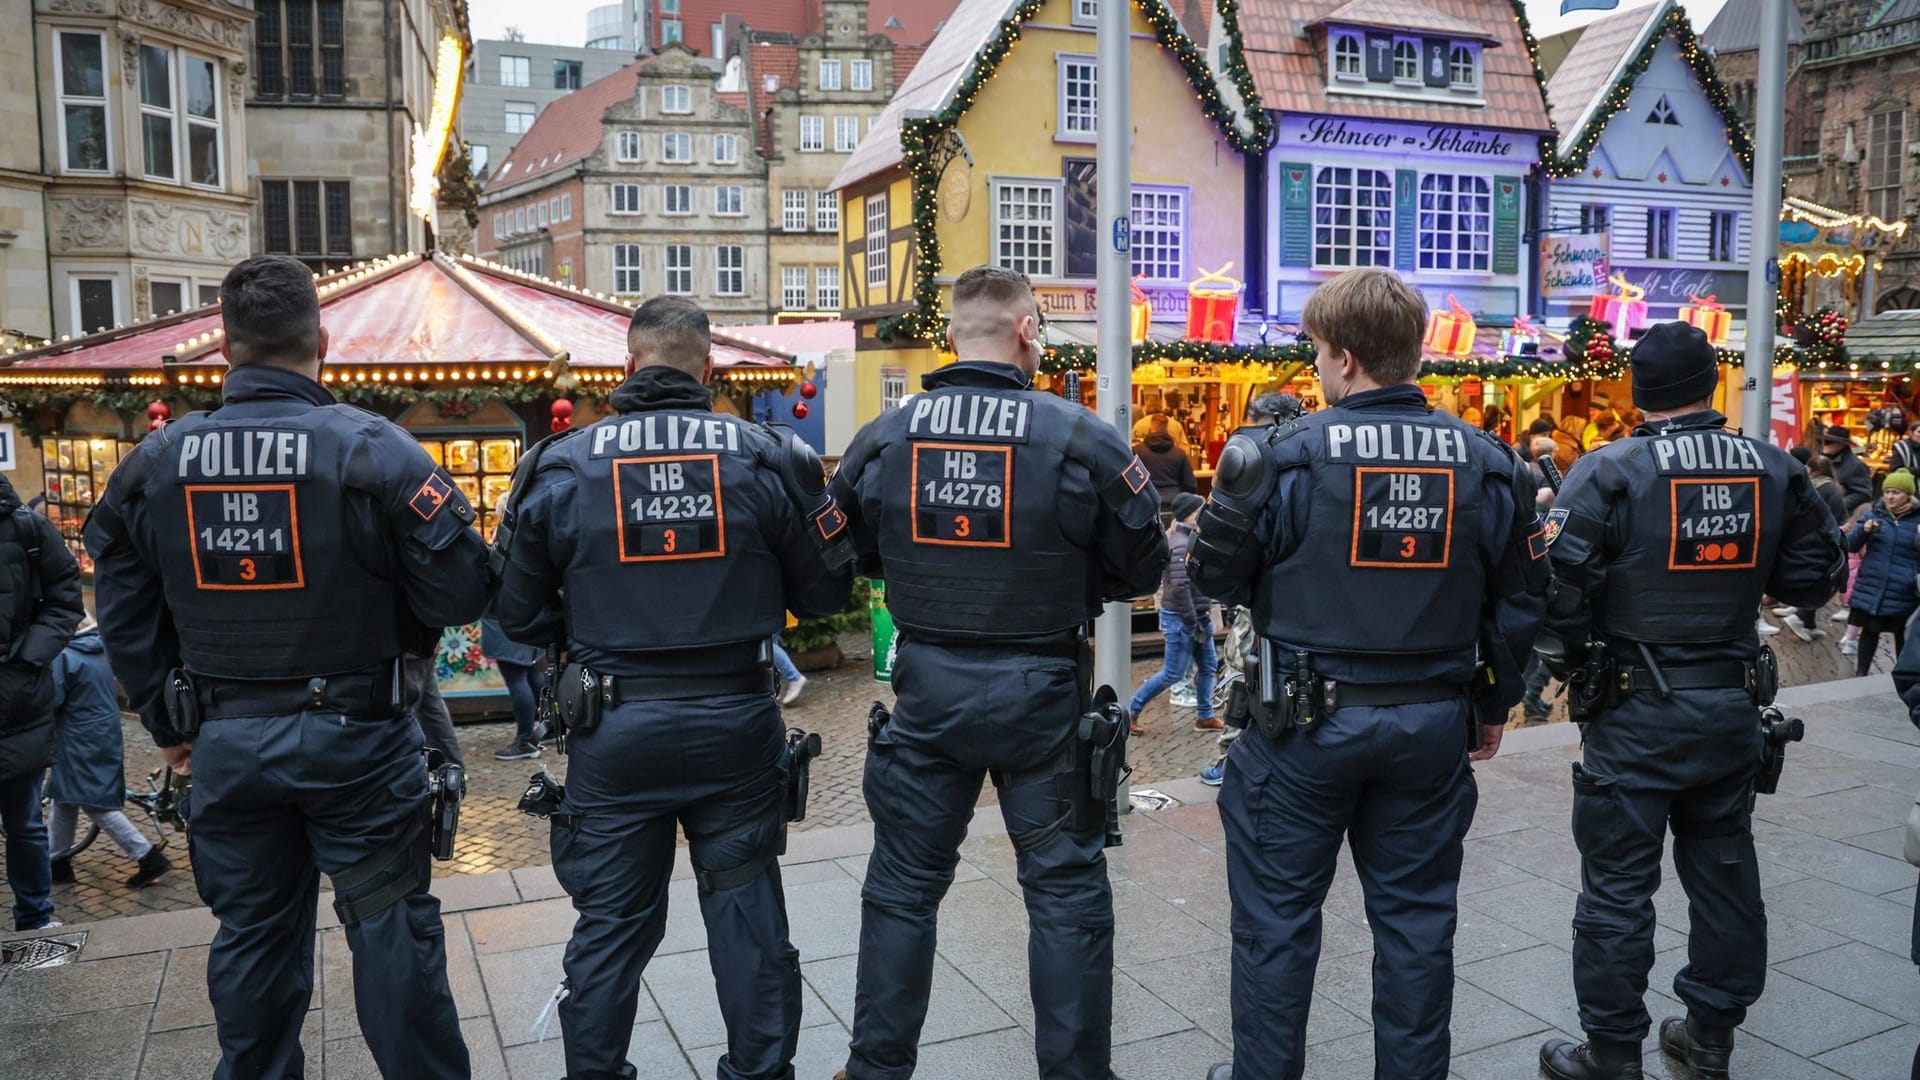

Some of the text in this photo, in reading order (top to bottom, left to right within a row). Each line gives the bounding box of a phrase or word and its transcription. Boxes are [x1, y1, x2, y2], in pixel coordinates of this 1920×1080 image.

[1300, 117, 1397, 148] Schnoor
[1419, 128, 1512, 156] Schänke
[1543, 269, 1594, 289] Schänke
[1041, 293, 1077, 313] zum
[909, 394, 1028, 438] POLIZEI
[593, 415, 739, 455] POLIZEI
[1328, 424, 1468, 463] POLIZEI
[178, 431, 308, 478] POLIZEI
[943, 450, 977, 480] HB
[1654, 434, 1765, 470] POLIZEI
[649, 462, 685, 492] HB
[1388, 473, 1422, 502] HB
[222, 492, 260, 522] HB
[422, 485, 443, 505] 3
[631, 494, 714, 521] 14232
[924, 480, 1002, 508] 14278
[1701, 484, 1733, 511] HB
[953, 514, 970, 537] 3
[1366, 505, 1444, 529] 14287
[1681, 512, 1752, 539] 14237
[200, 527, 284, 552] 14211
[663, 528, 676, 553] 3
[1400, 535, 1417, 558] 3
[239, 558, 257, 581] 3
